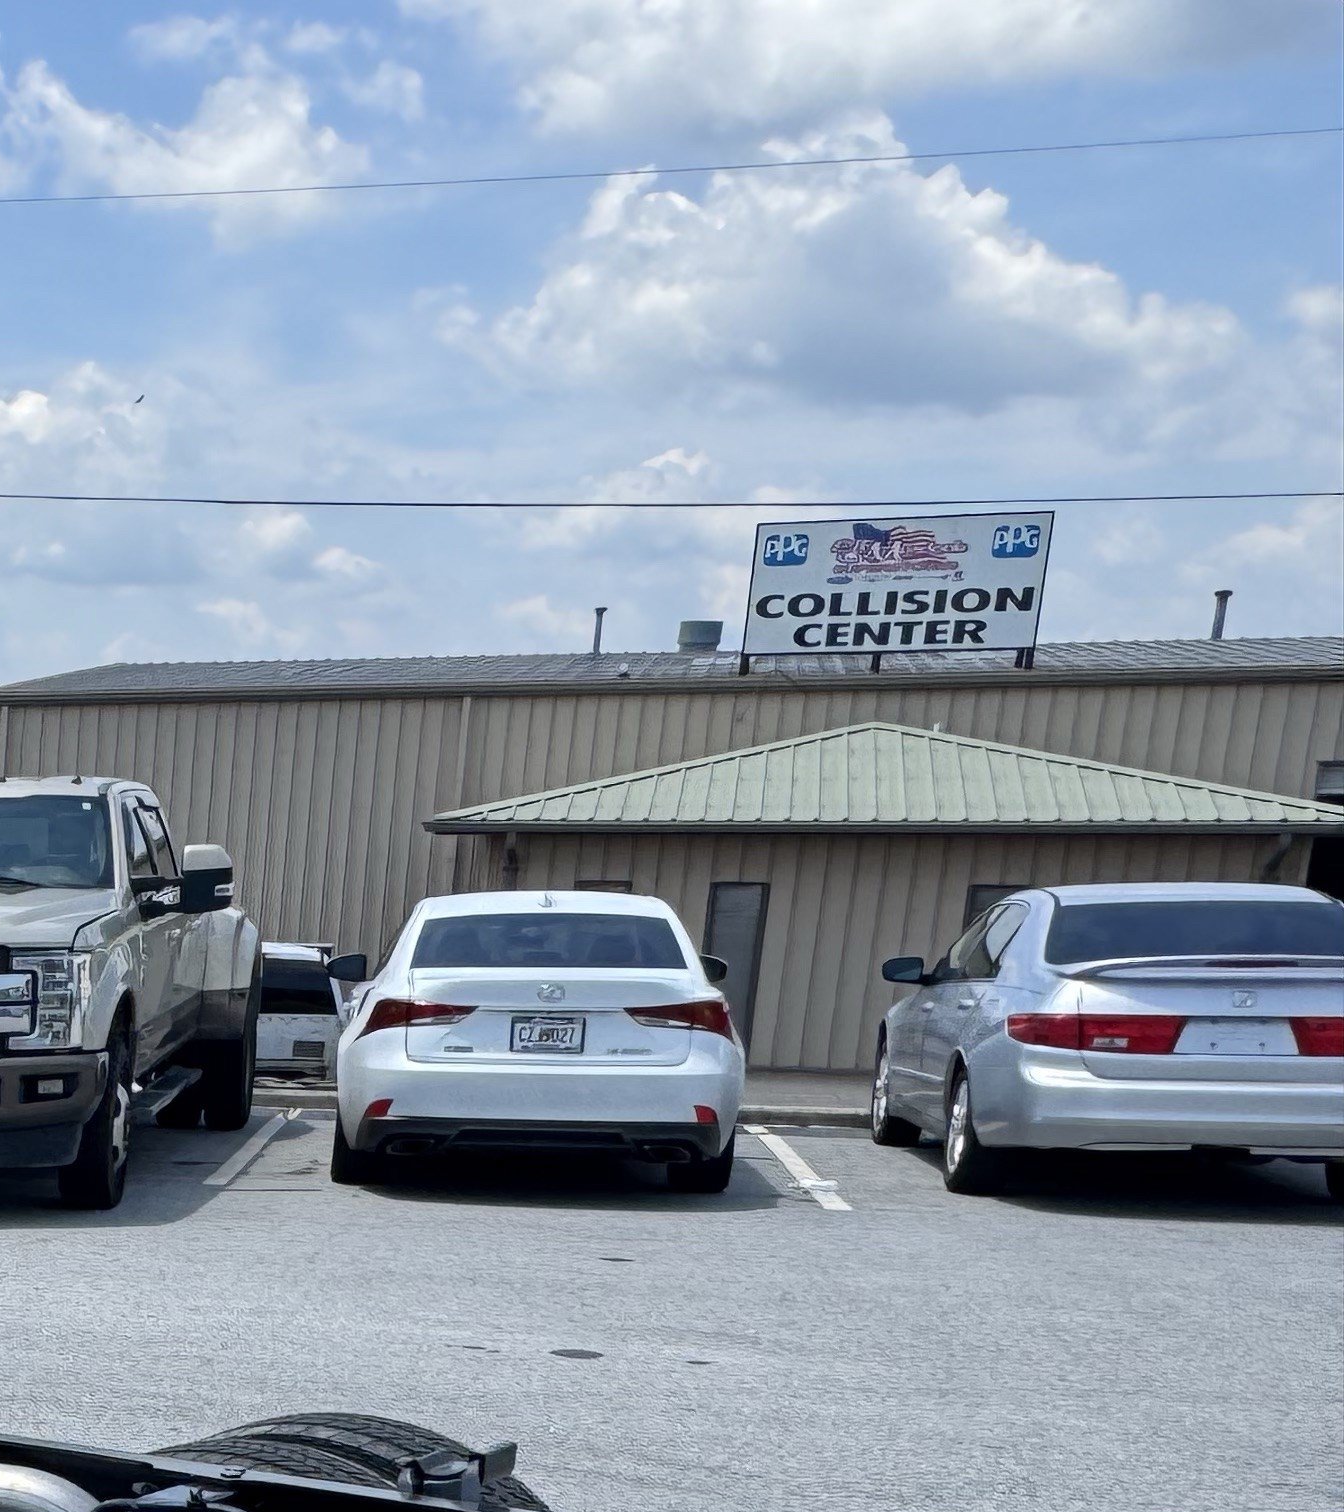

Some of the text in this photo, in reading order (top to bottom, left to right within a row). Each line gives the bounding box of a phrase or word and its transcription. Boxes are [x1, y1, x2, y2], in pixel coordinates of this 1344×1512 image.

[764, 534, 808, 562] PPG
[993, 525, 1040, 553] PPG
[756, 587, 1035, 619] COLLISION
[793, 619, 988, 648] CENTER
